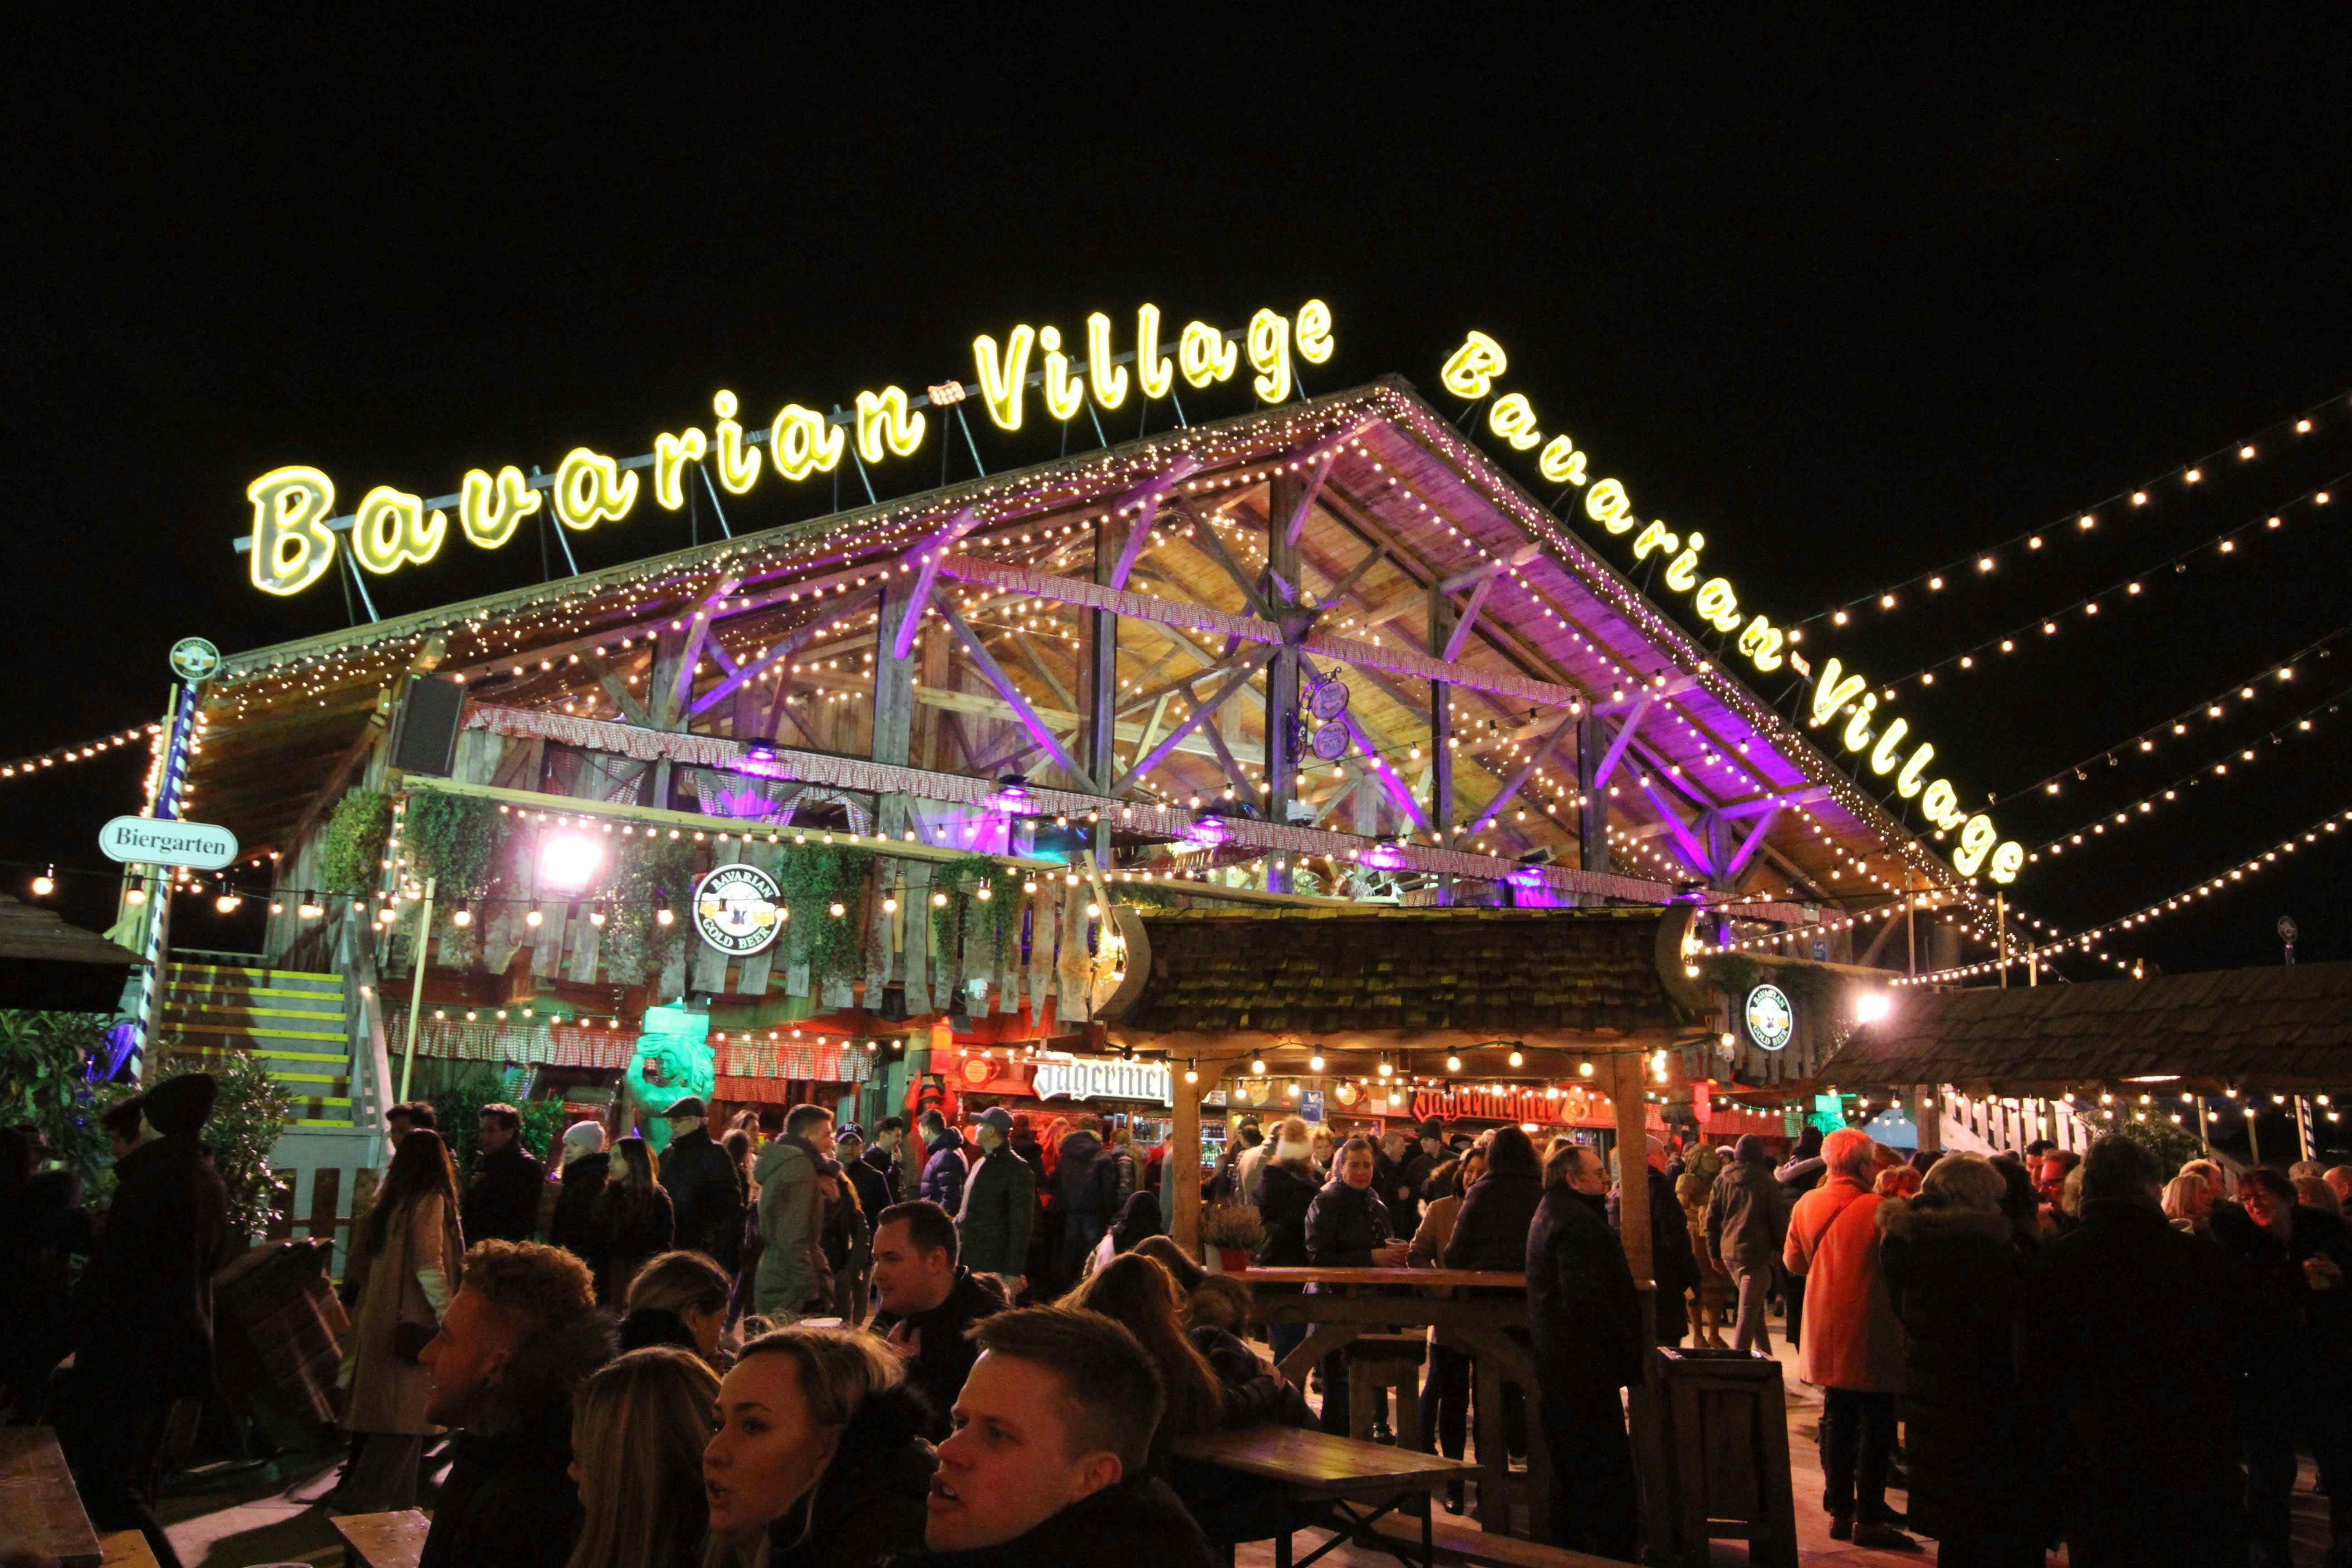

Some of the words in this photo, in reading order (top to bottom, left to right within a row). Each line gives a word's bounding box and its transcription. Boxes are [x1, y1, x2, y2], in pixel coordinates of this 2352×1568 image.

[244, 386, 926, 596] Bavarian
[972, 299, 1334, 431] Village
[1441, 331, 1783, 672] Bavarian
[1813, 658, 2023, 883] Village
[116, 827, 225, 854] Biergarten
[711, 871, 774, 898] BAVARIAN
[702, 918, 734, 947] GOLD
[738, 926, 772, 949] BEER
